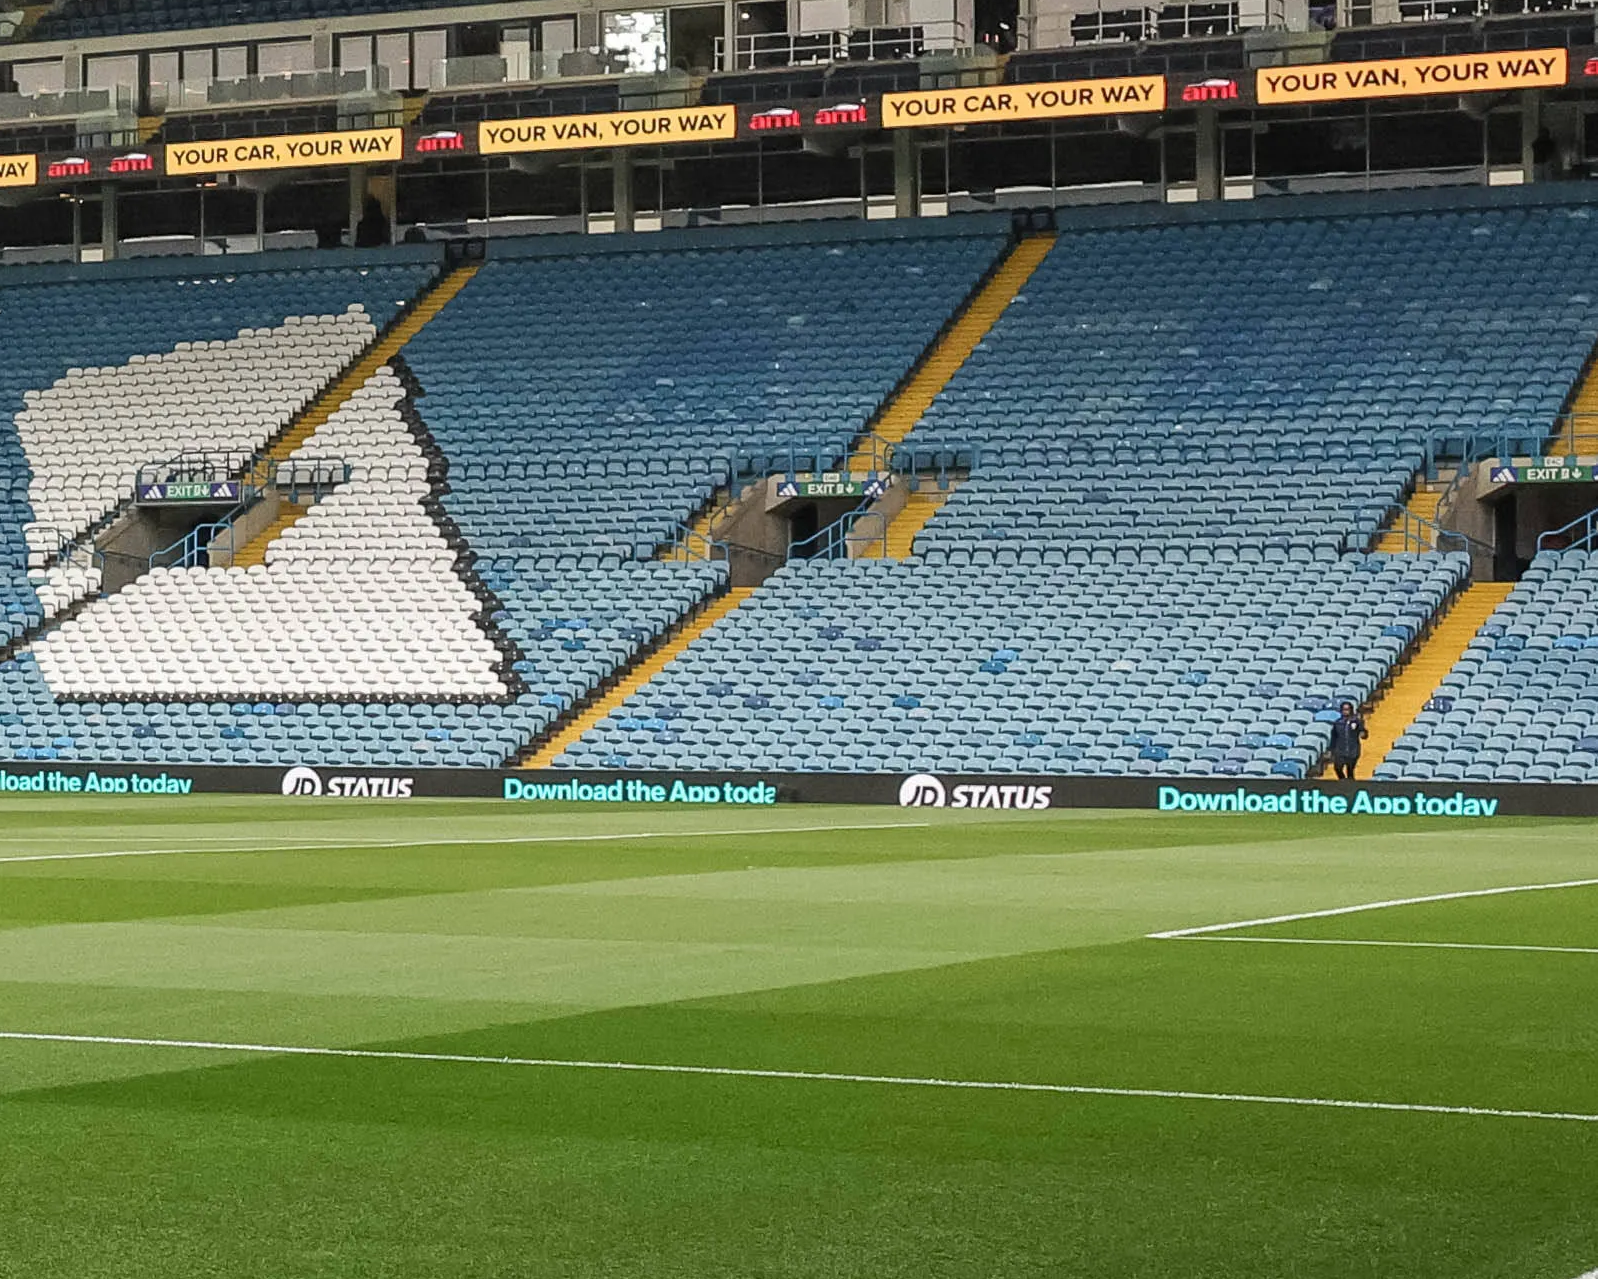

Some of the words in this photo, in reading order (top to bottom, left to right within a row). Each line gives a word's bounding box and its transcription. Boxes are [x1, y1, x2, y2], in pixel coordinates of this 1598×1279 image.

[1265, 72, 1338, 94] YOUR
[1344, 67, 1407, 89] VAN,
[1414, 61, 1489, 84] YOUR
[1496, 56, 1557, 79] WAY
[890, 97, 957, 118] YOUR
[963, 93, 1019, 113] CAR,
[1025, 87, 1094, 109] YOUR
[1100, 83, 1155, 104] WAY
[486, 125, 546, 145] YOUR
[552, 121, 603, 141] VAN,
[609, 117, 672, 137] YOUR
[677, 113, 727, 133] WAY
[172, 147, 229, 167] YOUR
[234, 144, 281, 162] CAR,
[286, 139, 343, 159] YOUR
[348, 135, 394, 155] WAY
[1527, 468, 1558, 480] EXIT
[167, 485, 191, 497] EXIT
[808, 484, 835, 495] EXIT
[47, 771, 82, 791] the
[327, 777, 414, 798] STATUS
[504, 778, 623, 801] Download
[625, 780, 667, 801] the
[951, 785, 1053, 809] STATUS
[1159, 787, 1297, 812] Download
[1300, 790, 1348, 813] the
